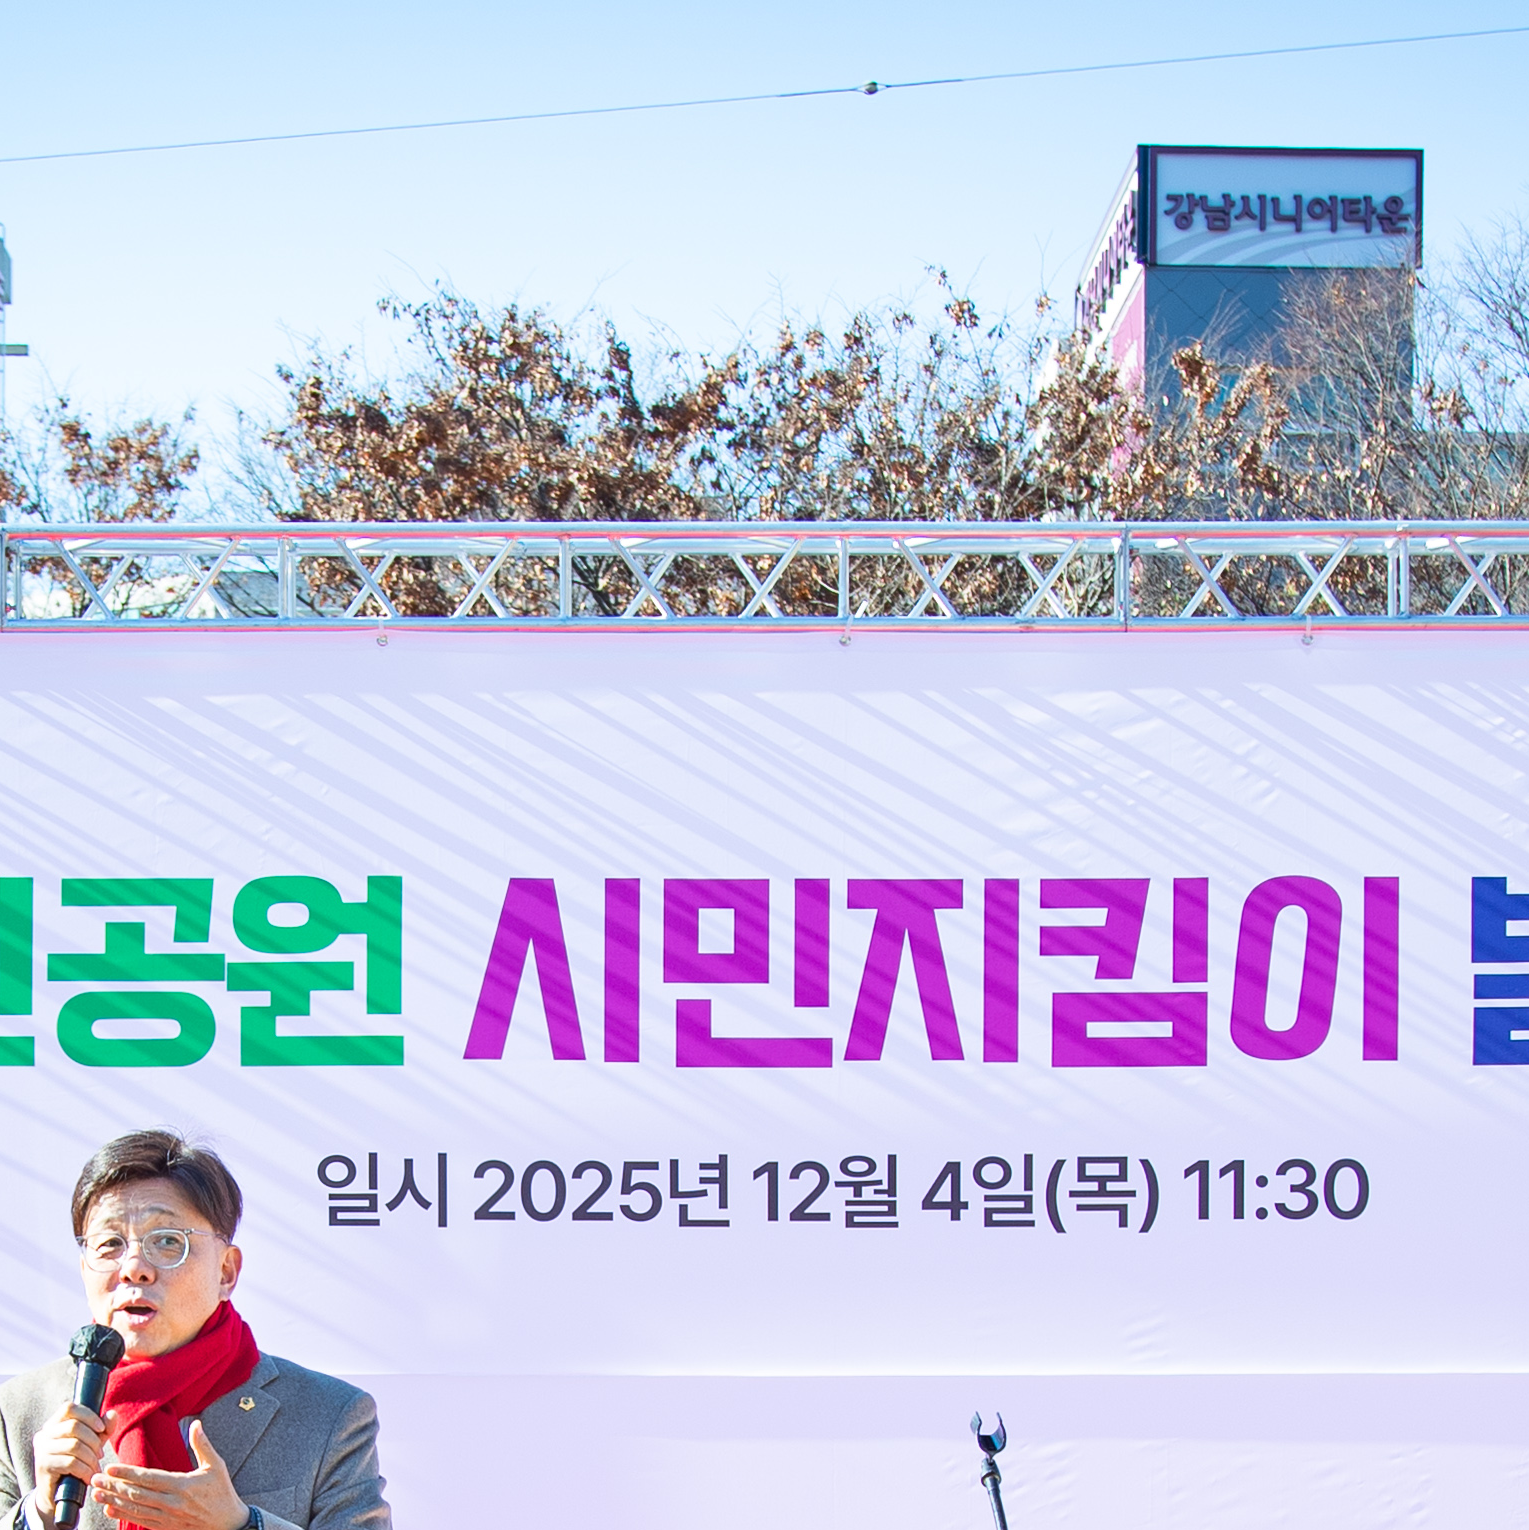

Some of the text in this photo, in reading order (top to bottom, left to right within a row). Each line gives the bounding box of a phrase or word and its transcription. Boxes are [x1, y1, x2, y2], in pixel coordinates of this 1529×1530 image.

[1164, 193, 1409, 234] 강남시니어타운
[461, 874, 1401, 1069] 시민지킴이
[316, 1151, 1370, 1234] 일시 2025년 12월 4일(목) 11:30
